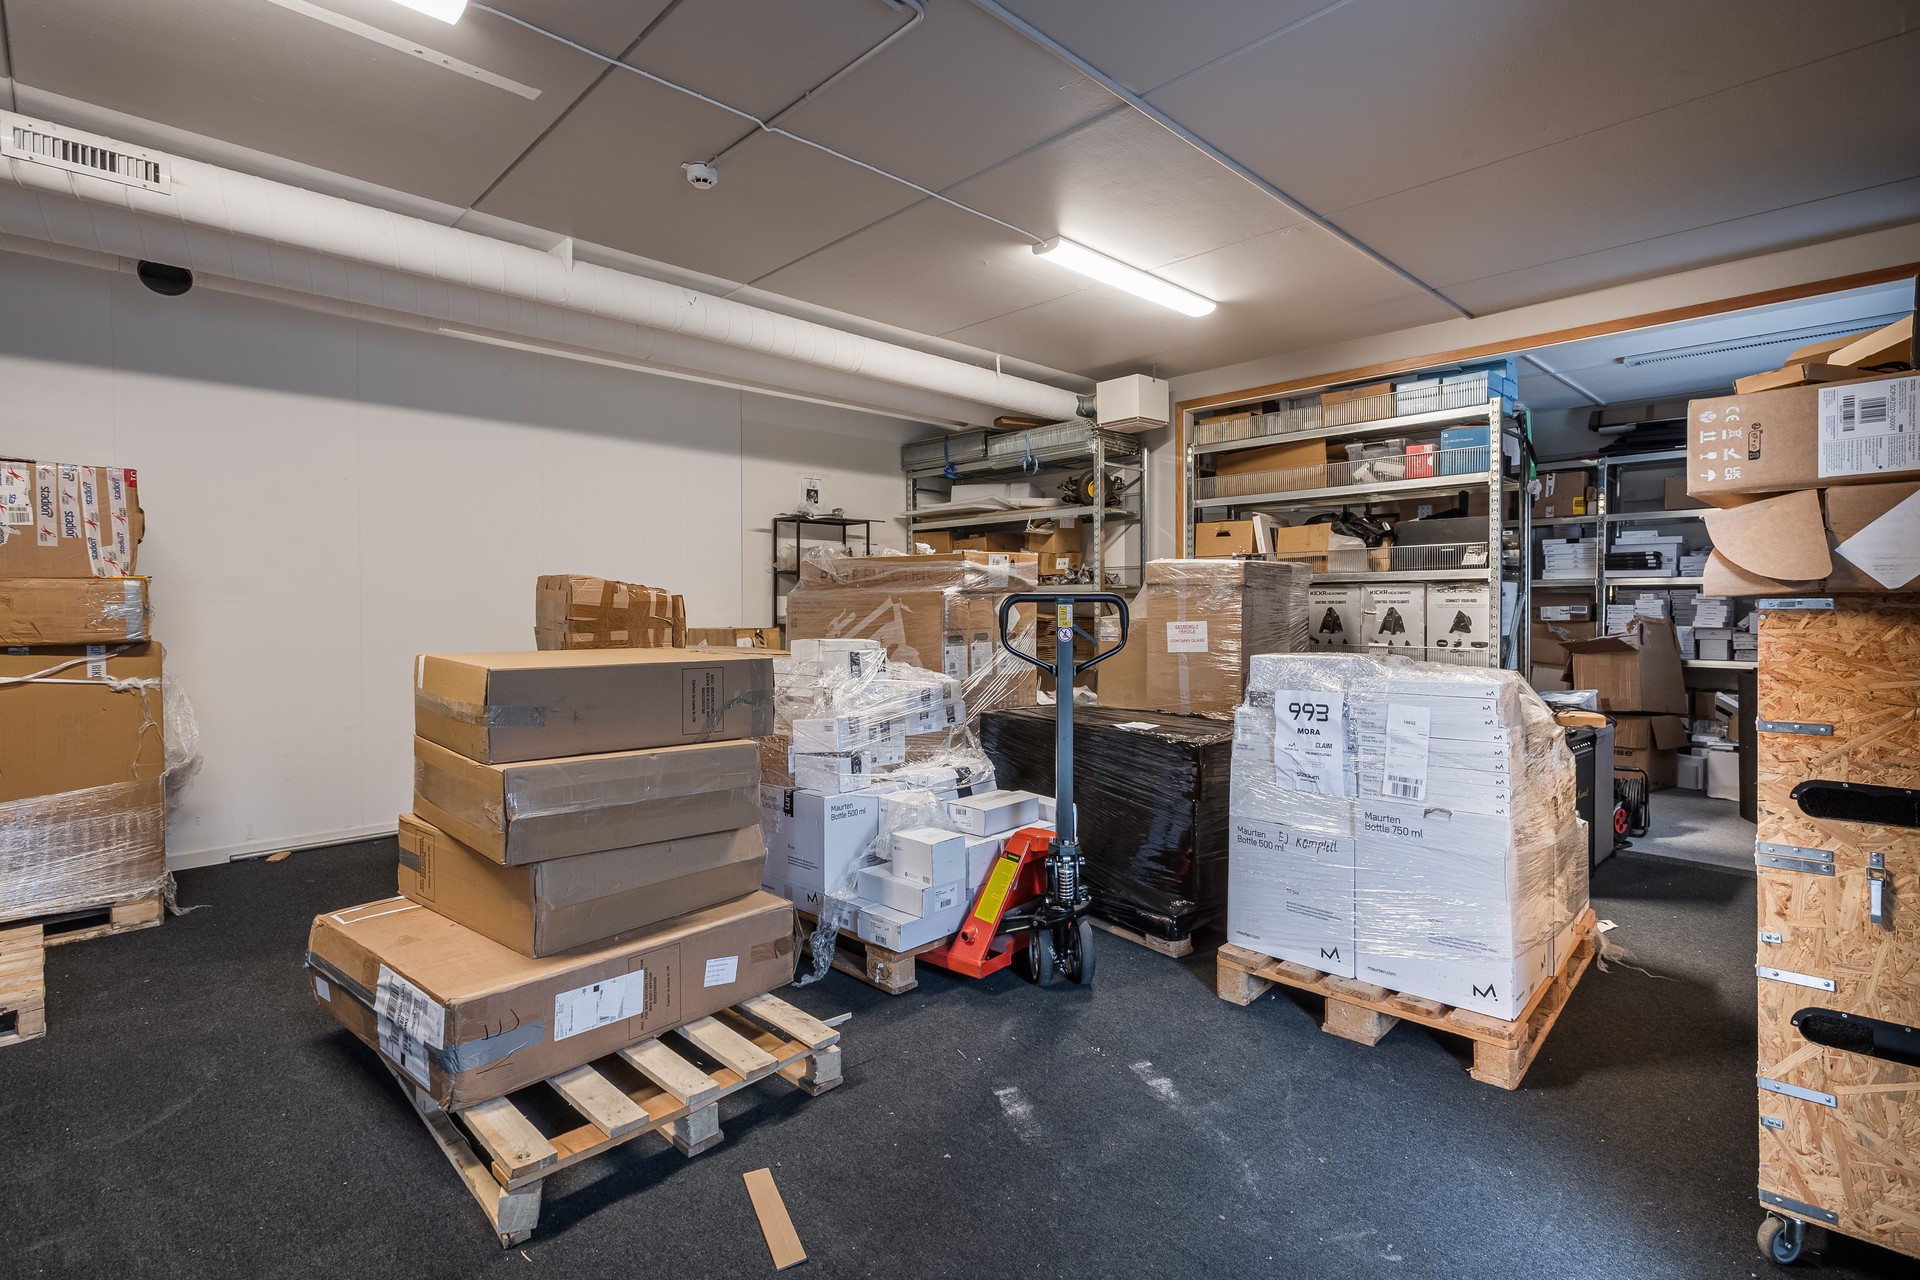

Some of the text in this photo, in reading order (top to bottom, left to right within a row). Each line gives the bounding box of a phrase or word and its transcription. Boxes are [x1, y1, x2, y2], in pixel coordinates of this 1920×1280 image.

[1733, 467, 1741, 479] UK
[83, 482, 92, 505] stadion
[112, 478, 122, 500] stadion
[41, 486, 53, 518] stadion
[88, 537, 98, 560] stadion
[1288, 702, 1330, 722] 993
[1297, 728, 1320, 736] MORA
[1315, 742, 1333, 750] CLAIM
[831, 803, 853, 812] Maurten
[831, 812, 847, 821] Bottle
[848, 809, 858, 817] 500
[1365, 812, 1400, 824] Maurten
[1237, 826, 1266, 839] Maurten
[1365, 822, 1423, 838] Bottle 750 ml
[1237, 835, 1258, 846] Bottle
[1259, 840, 1273, 849] 500
[1368, 966, 1397, 977] maurten.com
